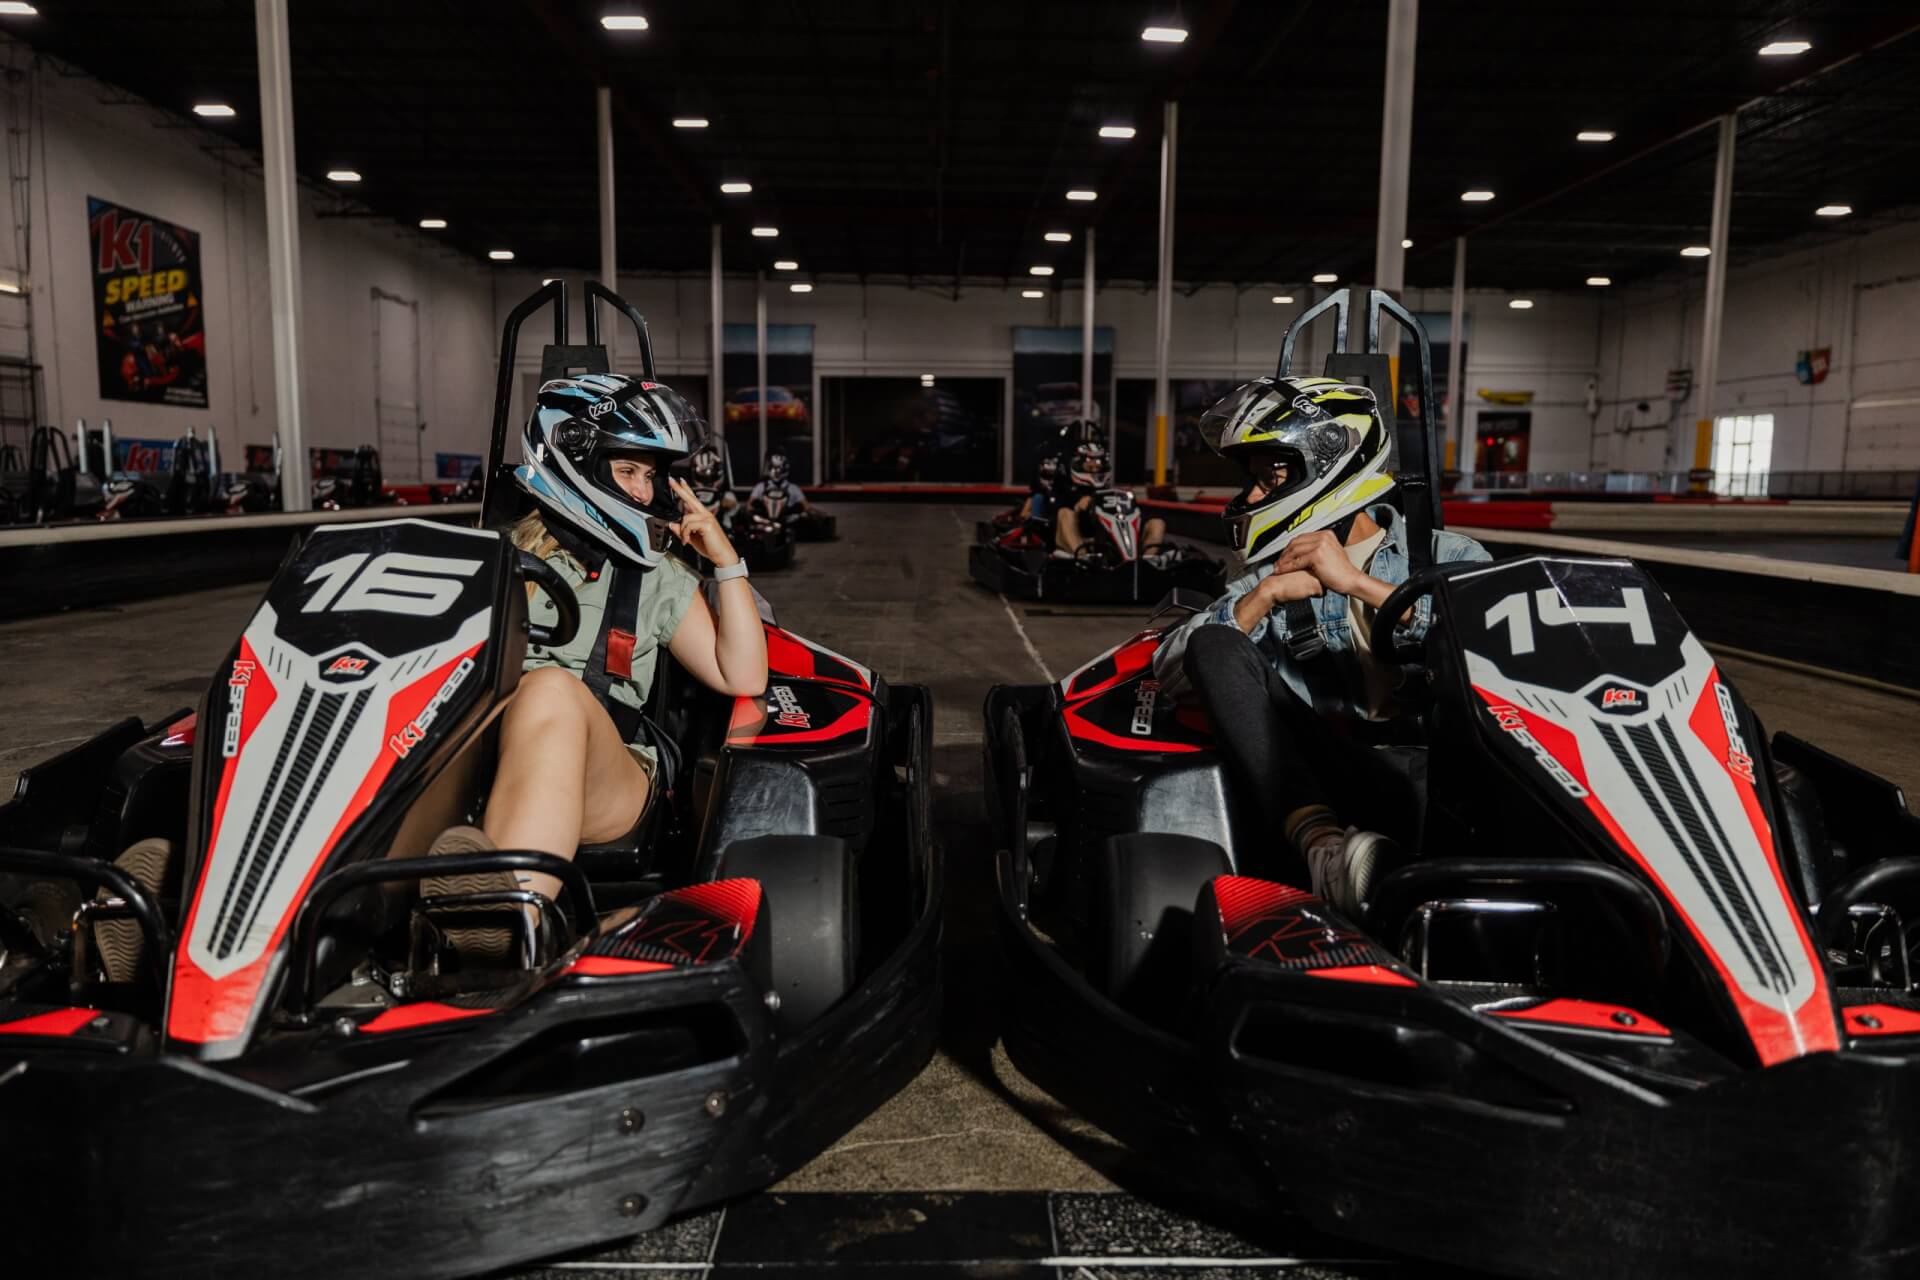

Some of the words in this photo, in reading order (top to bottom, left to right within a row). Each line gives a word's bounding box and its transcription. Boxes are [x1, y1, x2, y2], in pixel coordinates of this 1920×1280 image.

[98, 209, 153, 275] K1
[104, 267, 188, 305] SPEED
[300, 551, 484, 617] 16
[1484, 587, 1657, 656] 14
[327, 656, 369, 672] K1
[1603, 688, 1636, 706] K1
